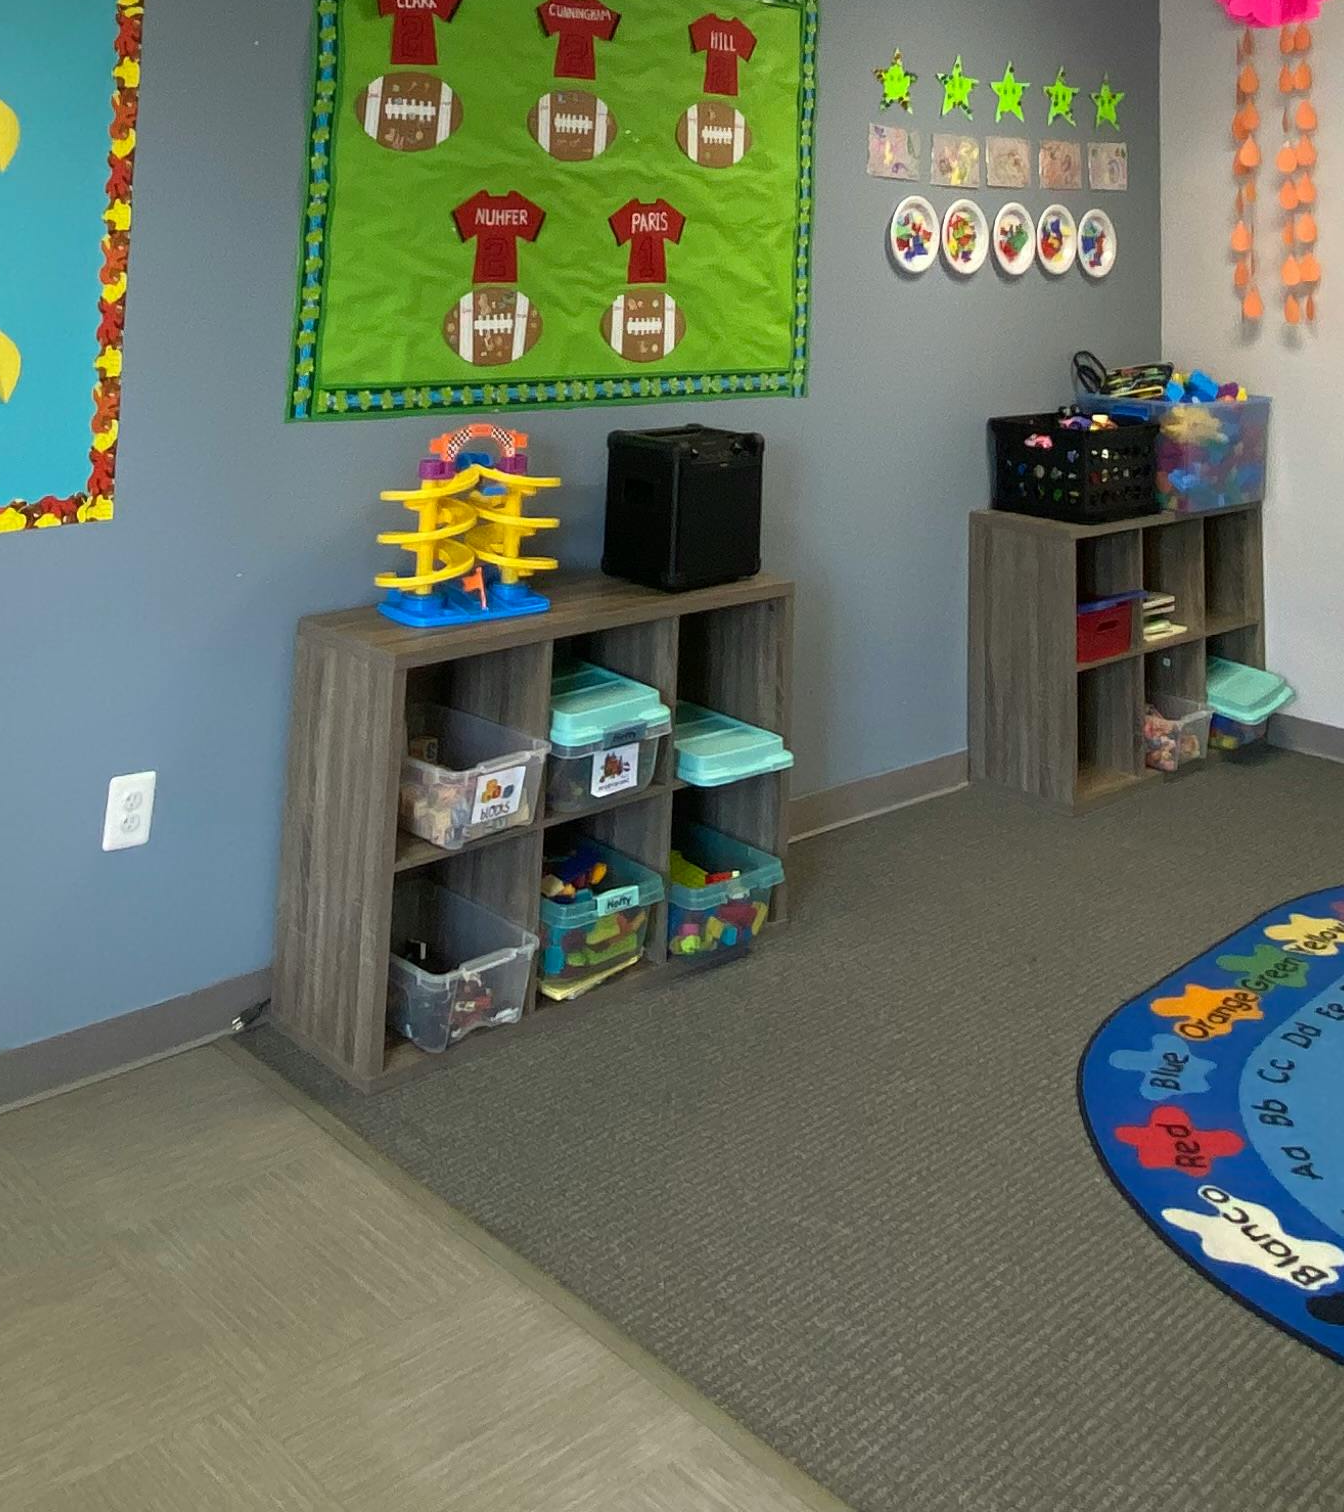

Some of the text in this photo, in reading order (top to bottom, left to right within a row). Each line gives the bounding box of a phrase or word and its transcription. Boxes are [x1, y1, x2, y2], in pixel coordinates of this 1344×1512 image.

[549, 4, 612, 21] CUNNINGHAM
[711, 31, 737, 52] HILL
[474, 208, 528, 226] NUHFER
[631, 212, 668, 234] PARIS
[607, 895, 632, 909] Hefty
[1241, 958, 1303, 993] Green
[1178, 991, 1260, 1039] Orange
[1281, 1023, 1322, 1049] Dd
[1150, 1051, 1189, 1091] Blue
[1258, 1059, 1296, 1084] Cc
[1253, 1099, 1294, 1127] Bb
[1156, 1122, 1207, 1170] Red
[1282, 1146, 1324, 1180] Aa
[1201, 1187, 1329, 1285] Blanco
